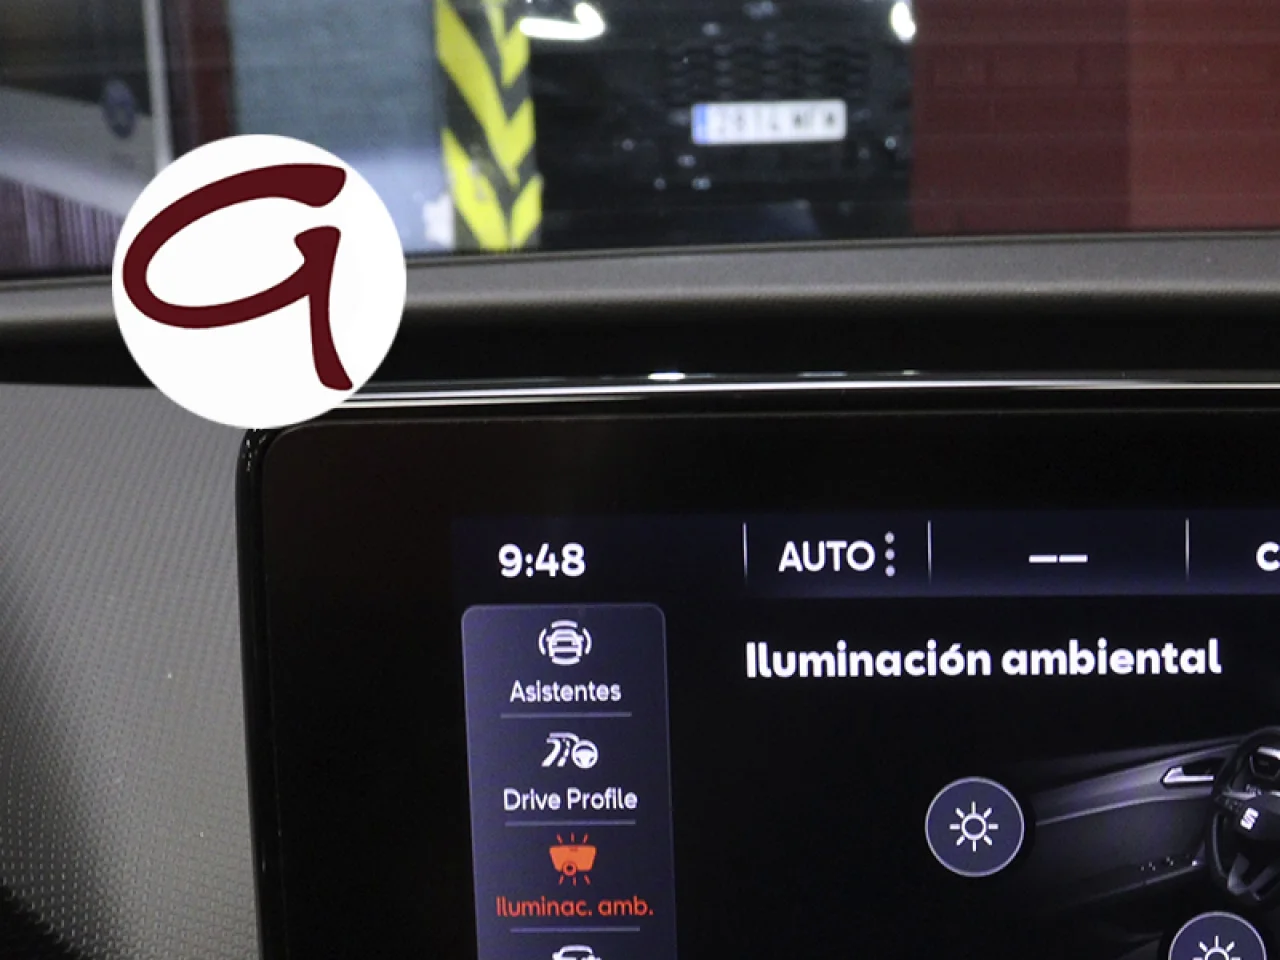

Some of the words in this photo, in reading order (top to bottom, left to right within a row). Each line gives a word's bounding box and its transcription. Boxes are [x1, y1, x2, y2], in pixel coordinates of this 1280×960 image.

[498, 542, 587, 578] 9:48
[778, 540, 876, 572] AUTO
[746, 638, 992, 678] Iluminación
[1001, 637, 1223, 676] ambiental
[509, 679, 622, 703] Asistentes
[503, 788, 561, 811] Drive
[567, 786, 638, 810] Profile
[496, 895, 593, 917] Iluminac.
[597, 895, 654, 916] amb.
